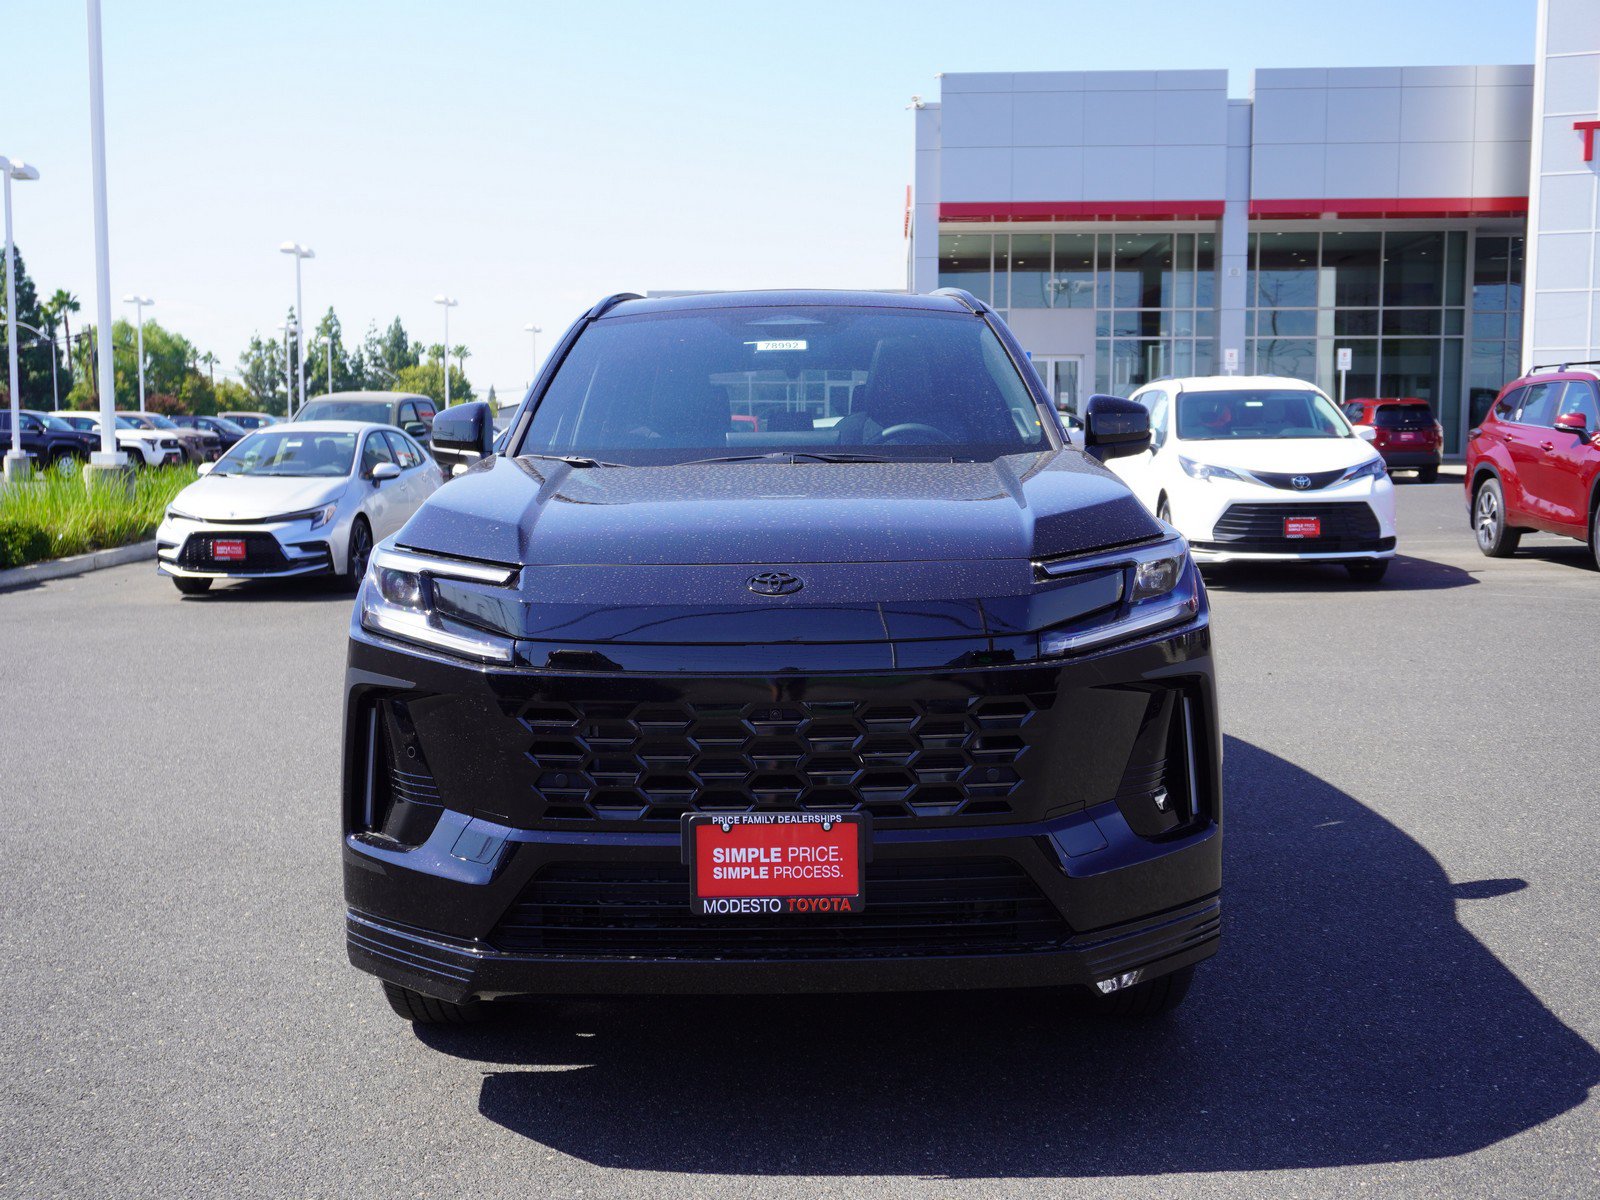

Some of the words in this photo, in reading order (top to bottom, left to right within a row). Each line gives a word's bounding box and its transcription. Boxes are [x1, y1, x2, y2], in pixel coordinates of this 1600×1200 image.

[712, 816, 740, 824] PRICE
[742, 816, 775, 824] FAMILY
[777, 815, 842, 823] DEALERSHIPS
[712, 847, 782, 863] SIMPLE
[788, 846, 844, 862] PRICE.
[713, 866, 769, 879] SIMPLE
[773, 865, 844, 879] PROCESS.
[703, 898, 782, 914] MODESTO
[786, 897, 852, 912] TOYOTA
